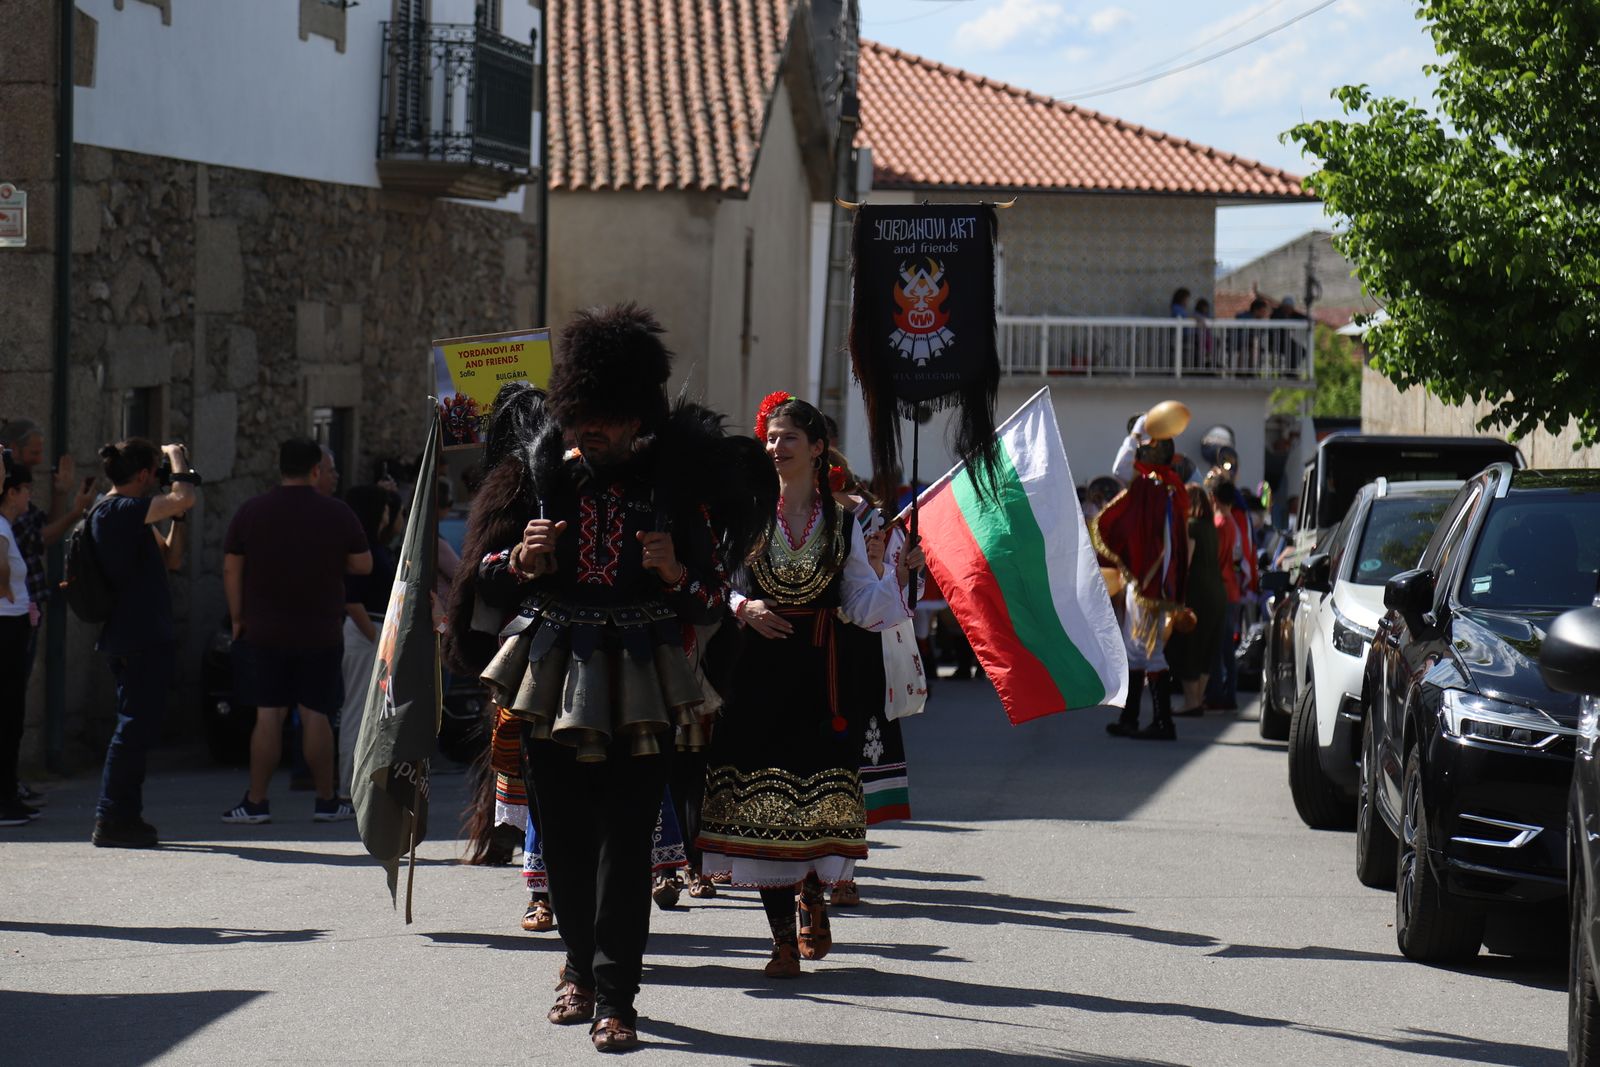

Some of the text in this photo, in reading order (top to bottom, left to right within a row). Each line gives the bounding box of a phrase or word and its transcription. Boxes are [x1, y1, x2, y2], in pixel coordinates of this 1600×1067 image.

[949, 217, 977, 239] ART
[893, 242, 959, 254] and friends
[458, 343, 525, 358] YORDANOVI ART
[465, 355, 519, 369] AND FRIENDS
[459, 369, 476, 378] Sofia
